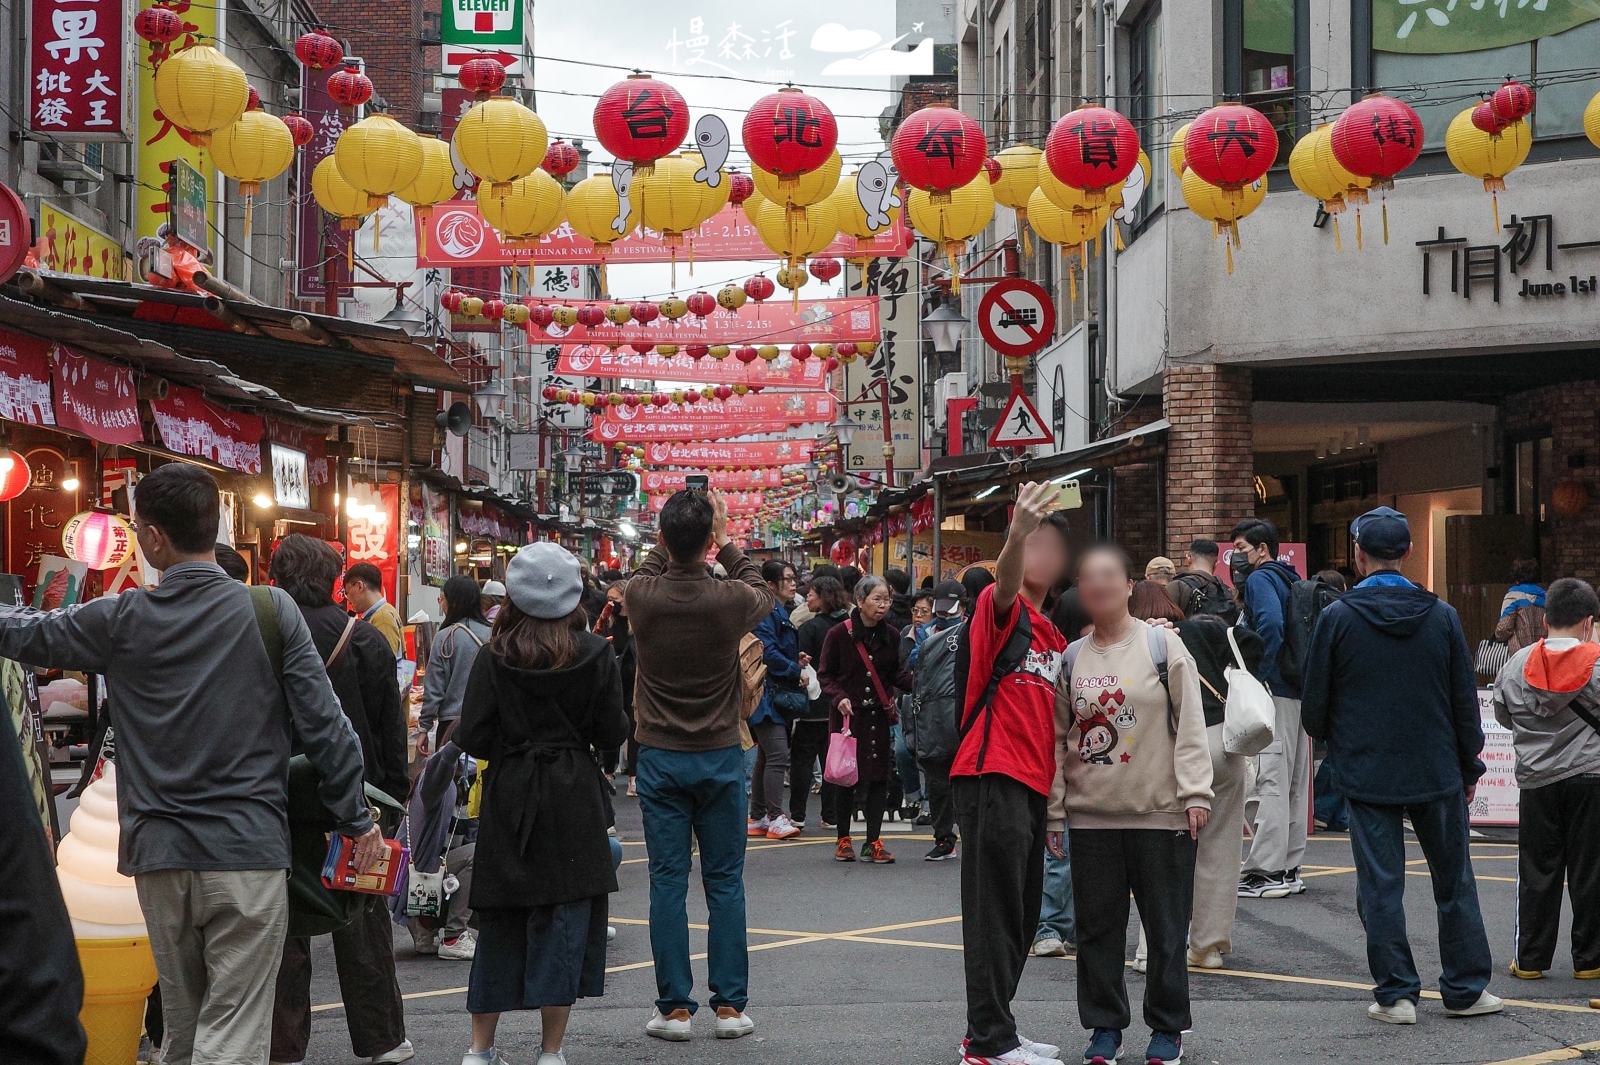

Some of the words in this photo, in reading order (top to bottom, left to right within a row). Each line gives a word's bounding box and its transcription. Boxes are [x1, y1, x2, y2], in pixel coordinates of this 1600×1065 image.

[35, 68, 73, 127] 批發
[82, 69, 117, 126] 大王
[622, 90, 675, 139] 台
[773, 107, 822, 148] 北
[916, 121, 966, 170] 年
[1069, 121, 1118, 171] 貨
[1207, 120, 1259, 158] 大
[1372, 115, 1416, 149] 街
[722, 225, 751, 238] 2.15
[499, 248, 532, 256] TAIPEI
[534, 248, 567, 256] LUNAR
[570, 248, 593, 256] NEW
[623, 246, 669, 254] FESTIVAL
[1518, 279, 1566, 297] June
[1569, 276, 1597, 295] 1st
[746, 320, 768, 329] 2.15
[1076, 676, 1119, 688] LABUBU
